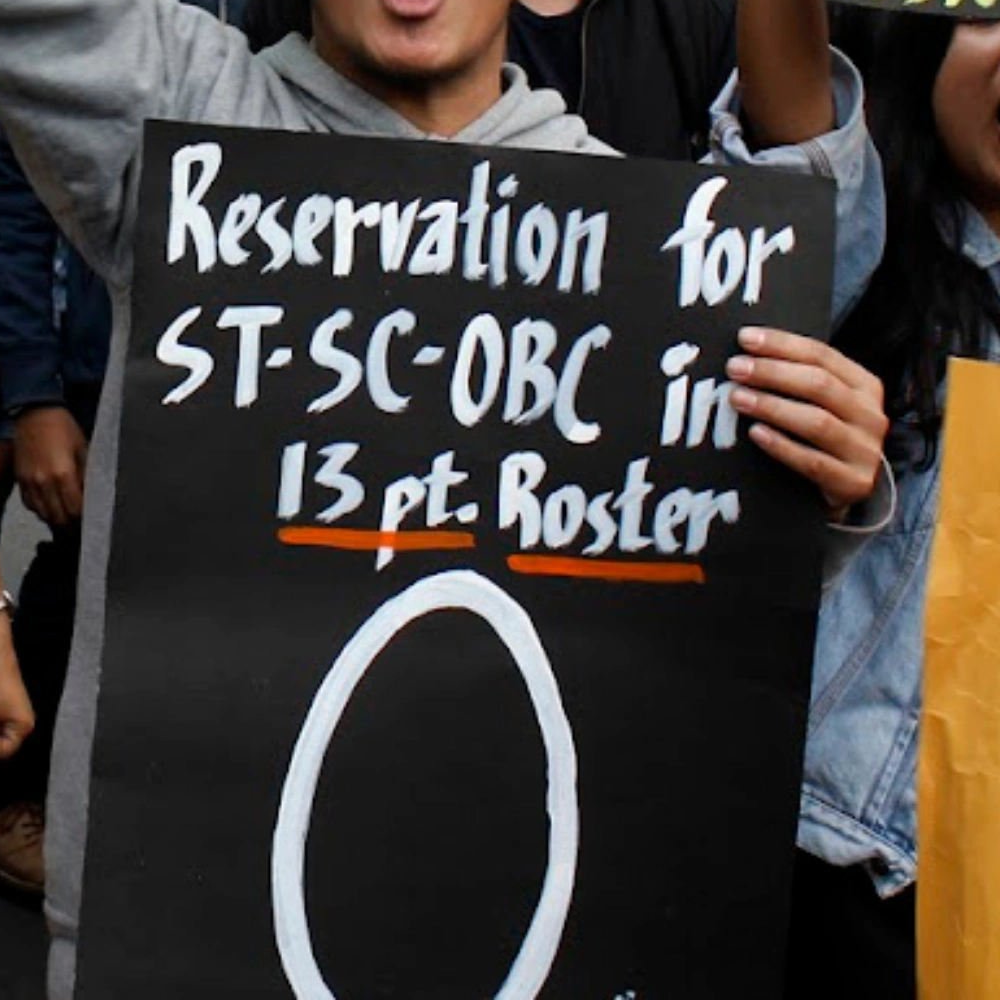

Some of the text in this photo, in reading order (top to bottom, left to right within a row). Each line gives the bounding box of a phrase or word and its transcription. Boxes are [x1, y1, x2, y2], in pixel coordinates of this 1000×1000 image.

[166, 142, 796, 307] Reservation for
[660, 341, 739, 449] in
[278, 441, 740, 570] 13 pt. Roster
